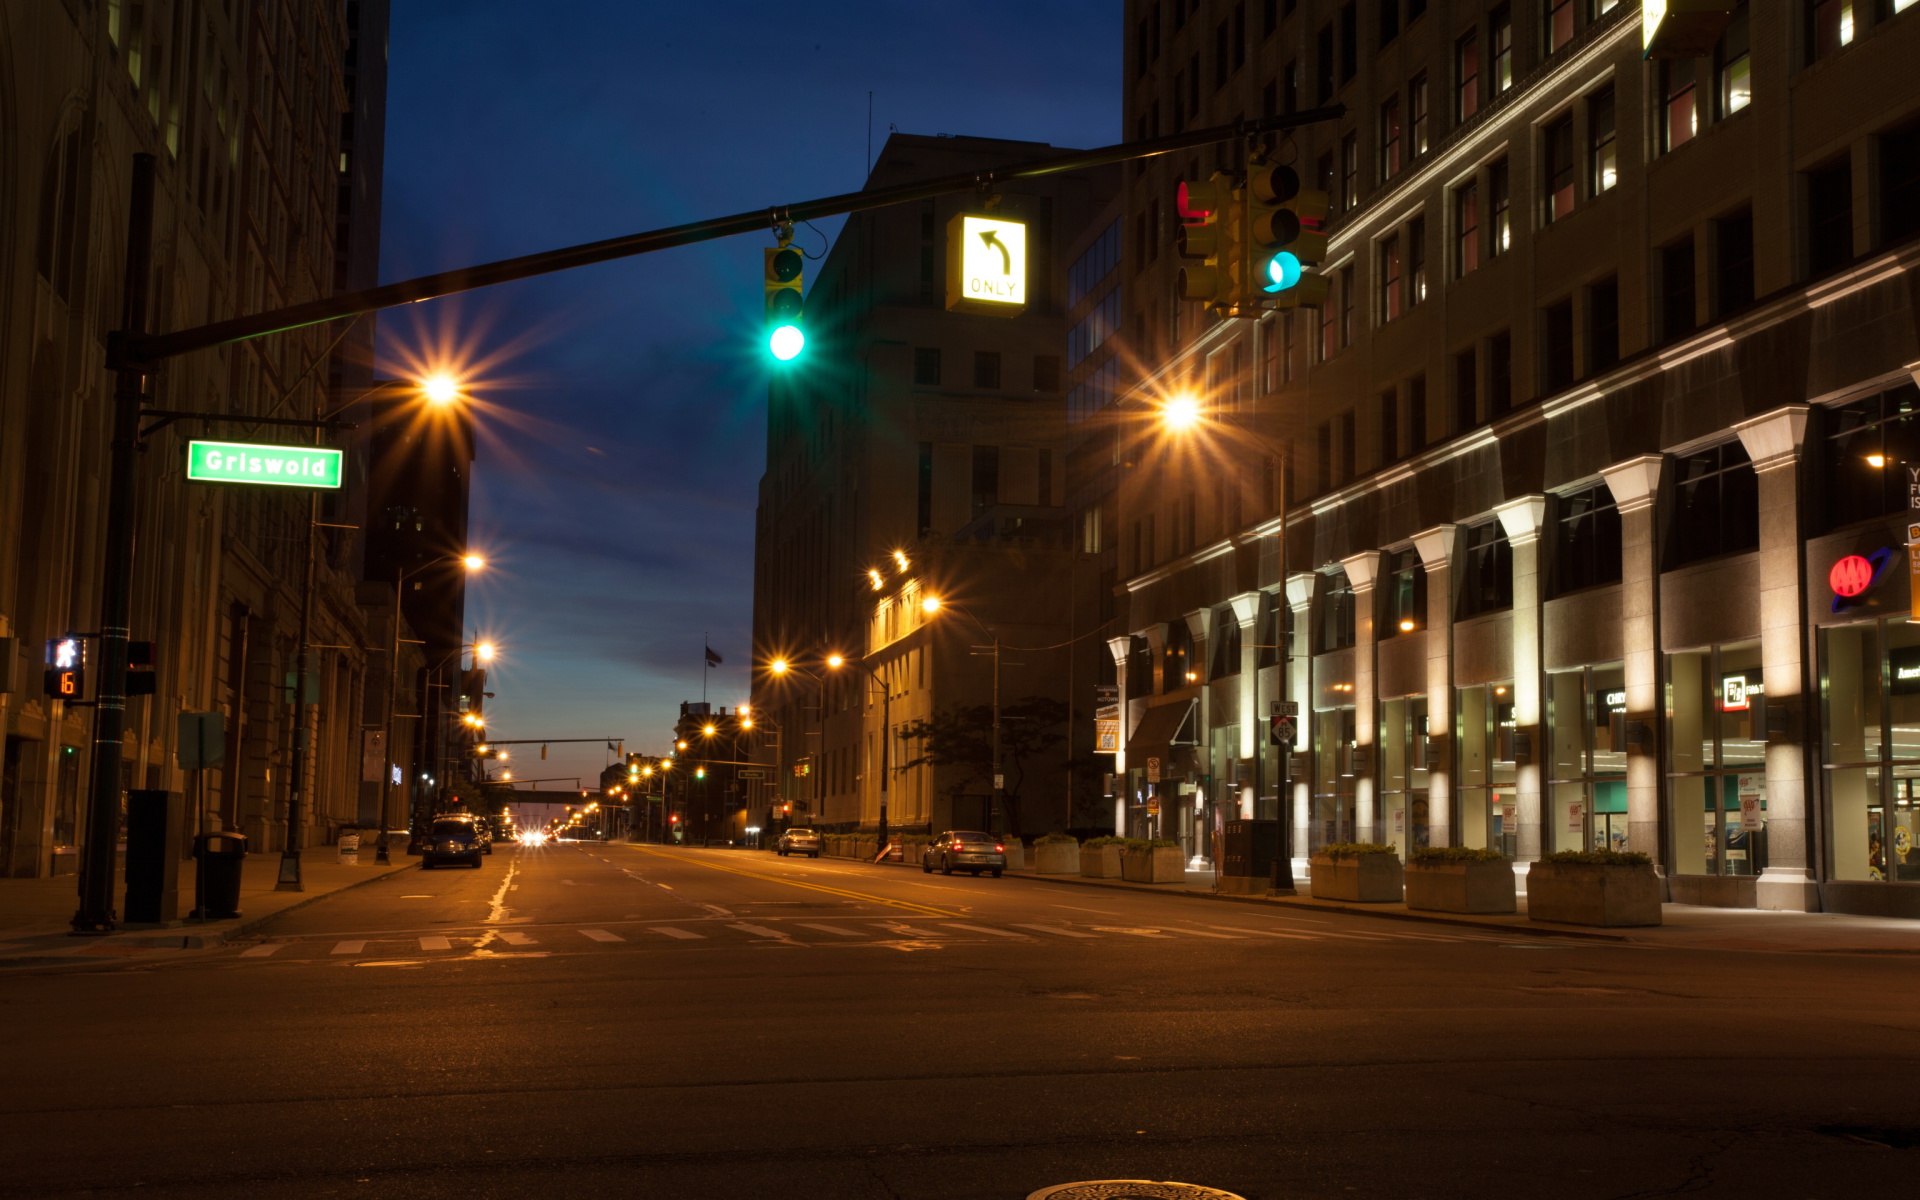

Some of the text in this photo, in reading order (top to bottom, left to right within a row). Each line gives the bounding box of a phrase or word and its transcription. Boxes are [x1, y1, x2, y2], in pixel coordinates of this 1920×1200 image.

[971, 277, 1016, 297] ONLY
[205, 450, 326, 477] Griswold
[61, 672, 74, 694] 16
[1273, 703, 1296, 714] WEST
[1278, 727, 1291, 738] 85
